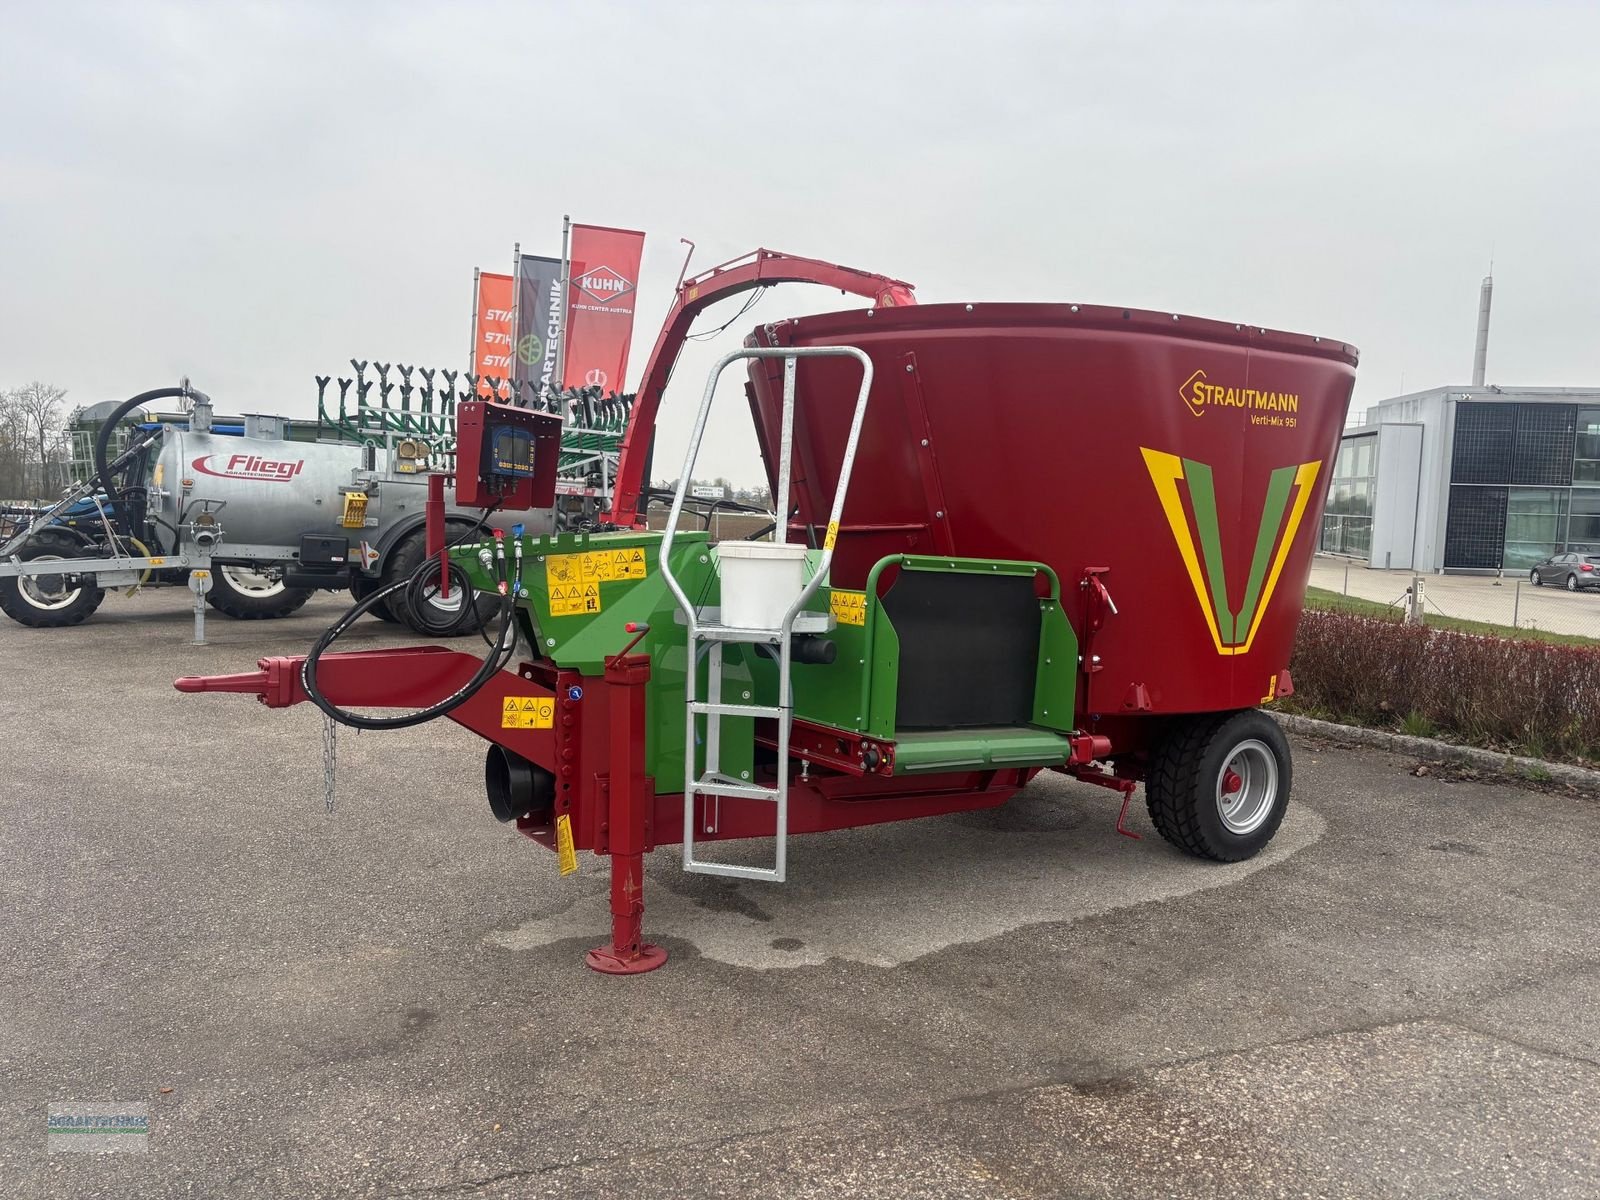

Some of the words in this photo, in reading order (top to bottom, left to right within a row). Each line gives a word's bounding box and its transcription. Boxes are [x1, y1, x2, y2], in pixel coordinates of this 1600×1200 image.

[582, 276, 625, 292] KUHN
[1192, 381, 1298, 413] STRAUTMANN
[1250, 414, 1284, 427] Verti-Mix
[1285, 417, 1297, 428] 951
[227, 454, 304, 478] Fliegl
